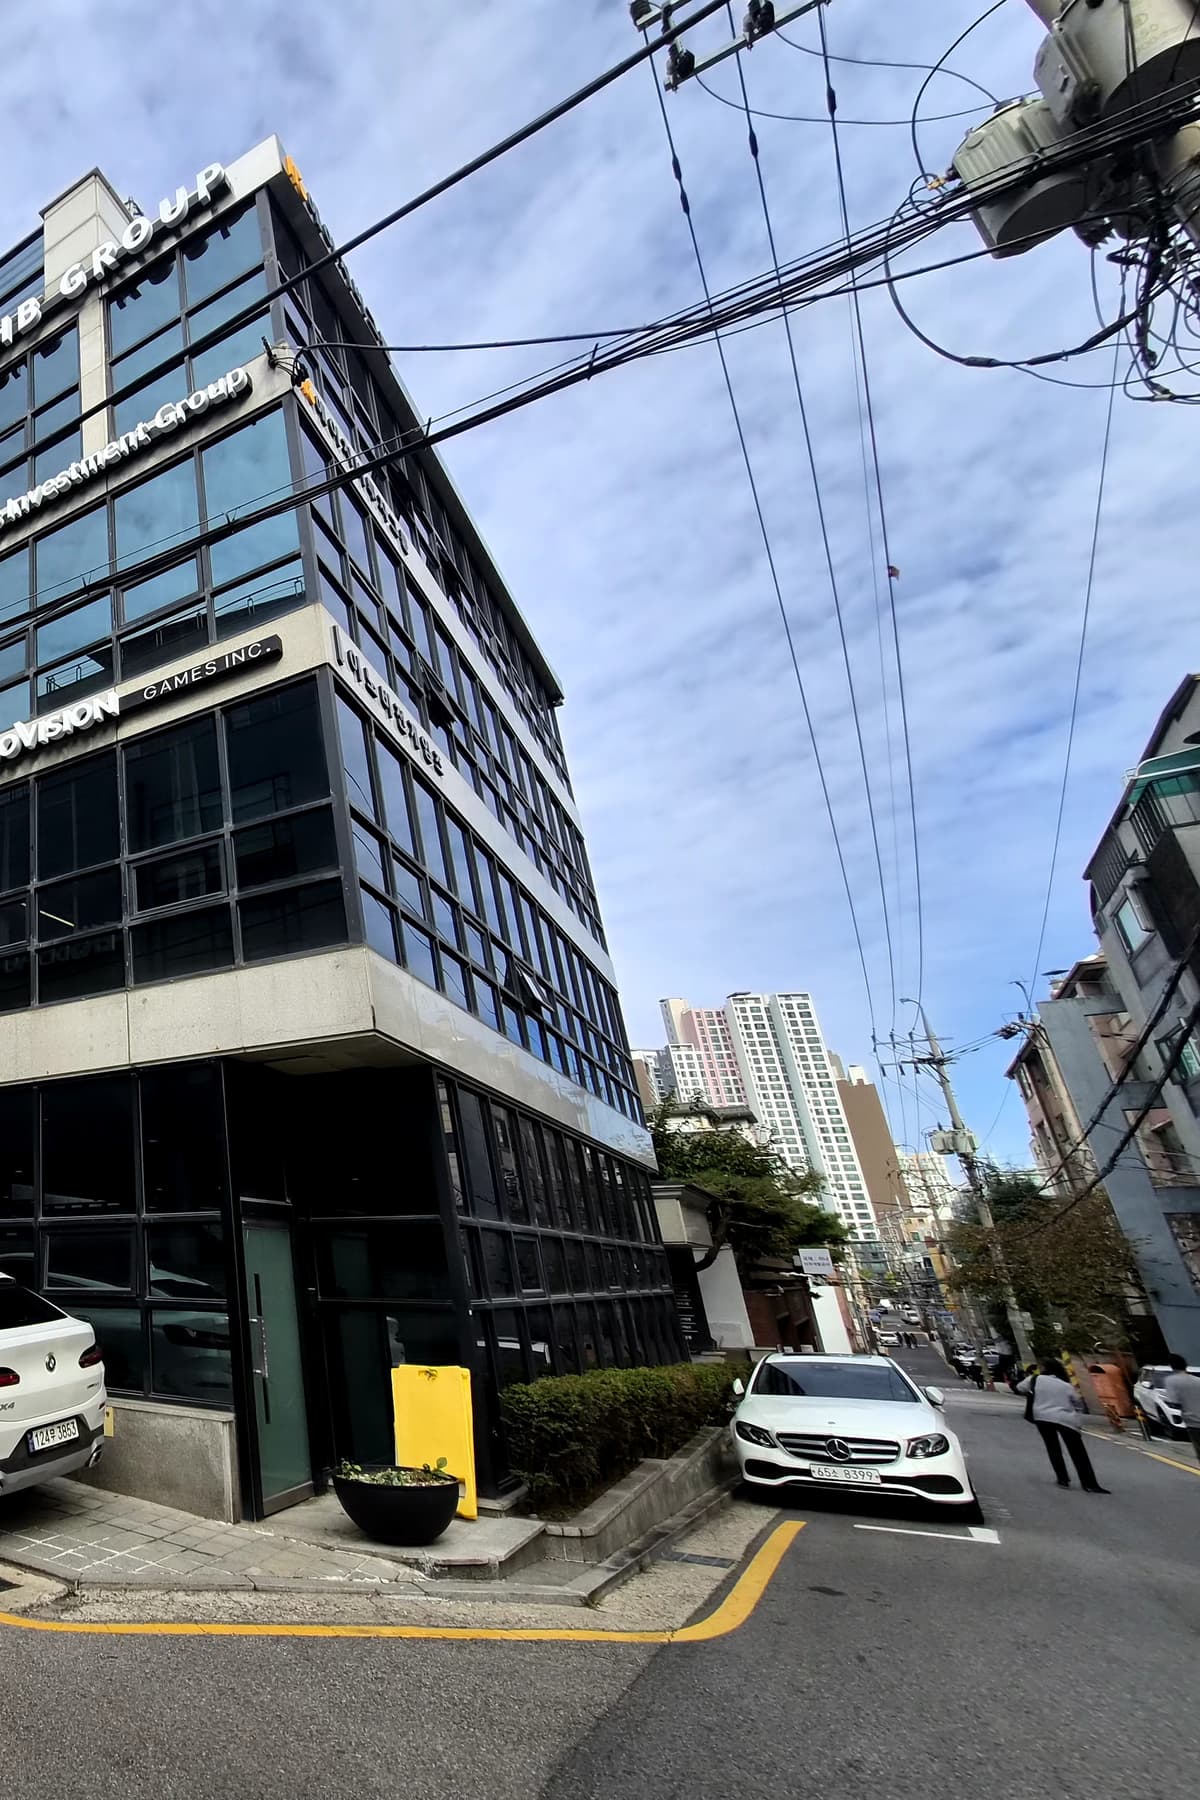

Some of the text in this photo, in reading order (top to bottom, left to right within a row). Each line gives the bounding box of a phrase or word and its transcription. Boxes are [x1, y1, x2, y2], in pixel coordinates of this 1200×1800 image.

[59, 162, 227, 299] GROUP
[4, 421, 153, 522] Investment
[154, 367, 250, 433] Group
[143, 642, 273, 701] GAMES INC.
[57, 1421, 77, 1441] 3853
[843, 1469, 873, 1481] 8399
